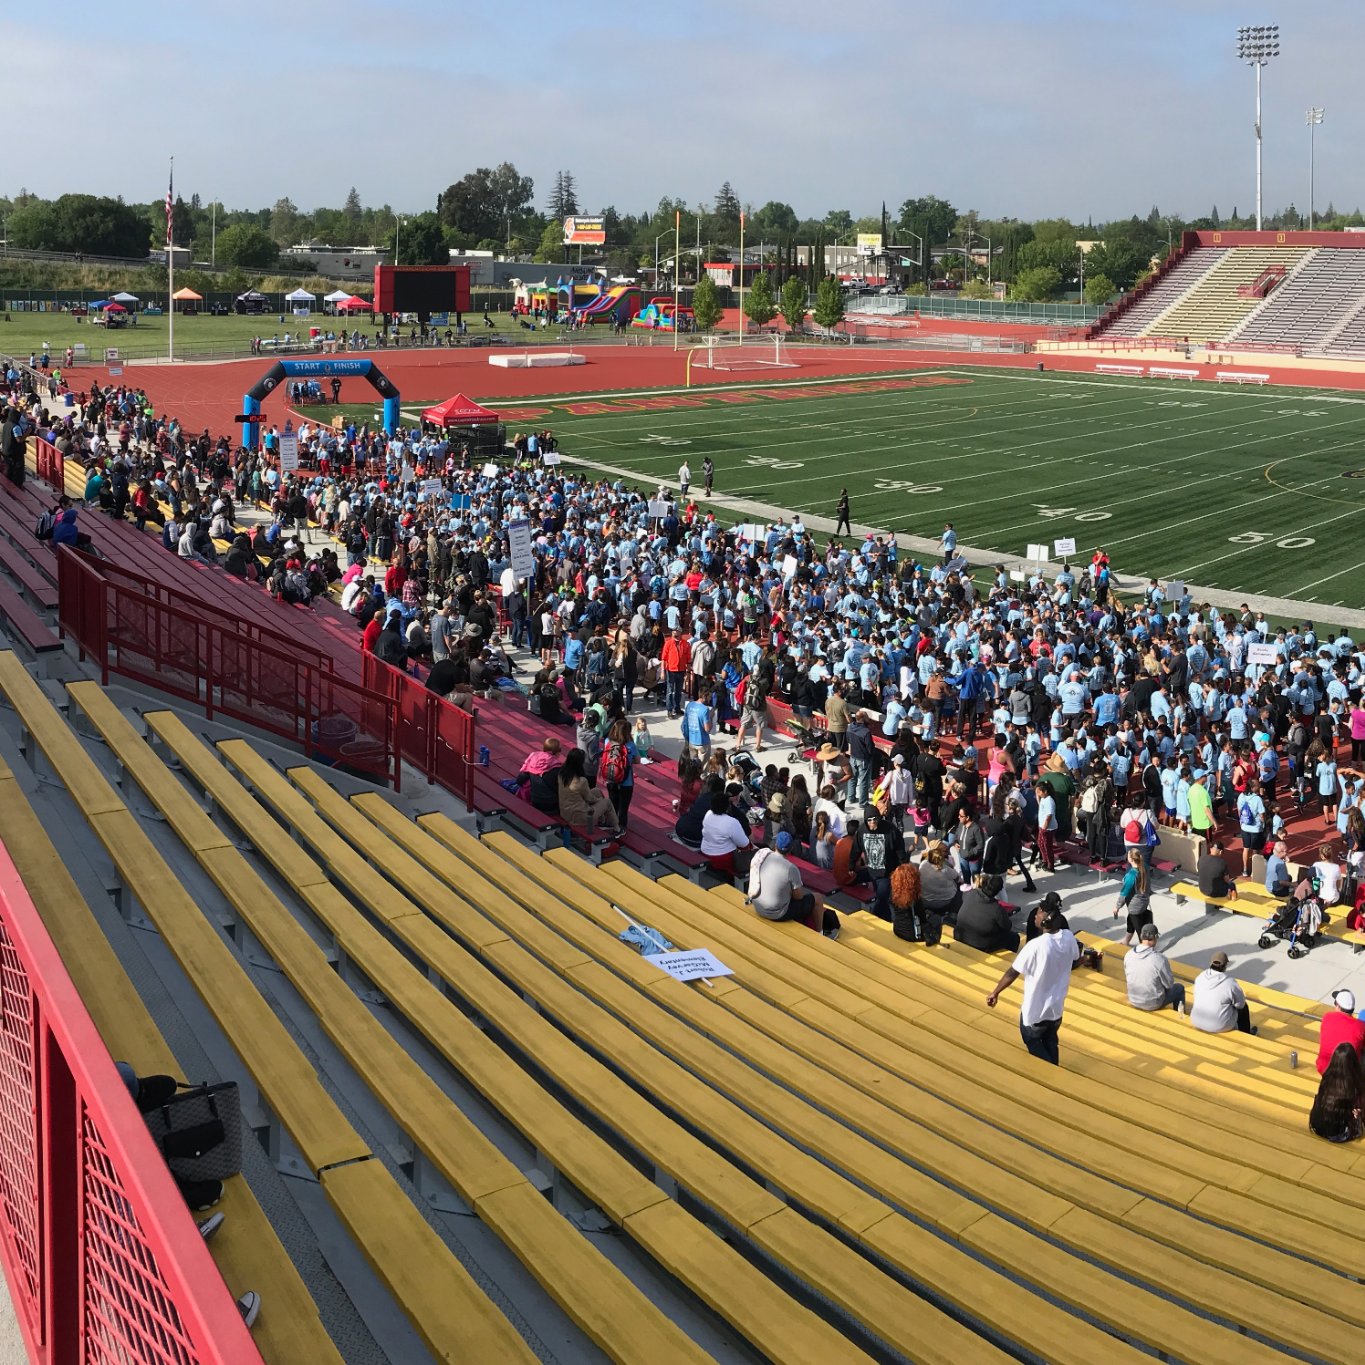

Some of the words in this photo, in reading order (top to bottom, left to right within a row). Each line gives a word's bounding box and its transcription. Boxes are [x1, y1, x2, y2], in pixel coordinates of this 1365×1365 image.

[295, 362, 320, 370] START
[334, 362, 360, 370] FINISH
[1227, 531, 1316, 549] 50
